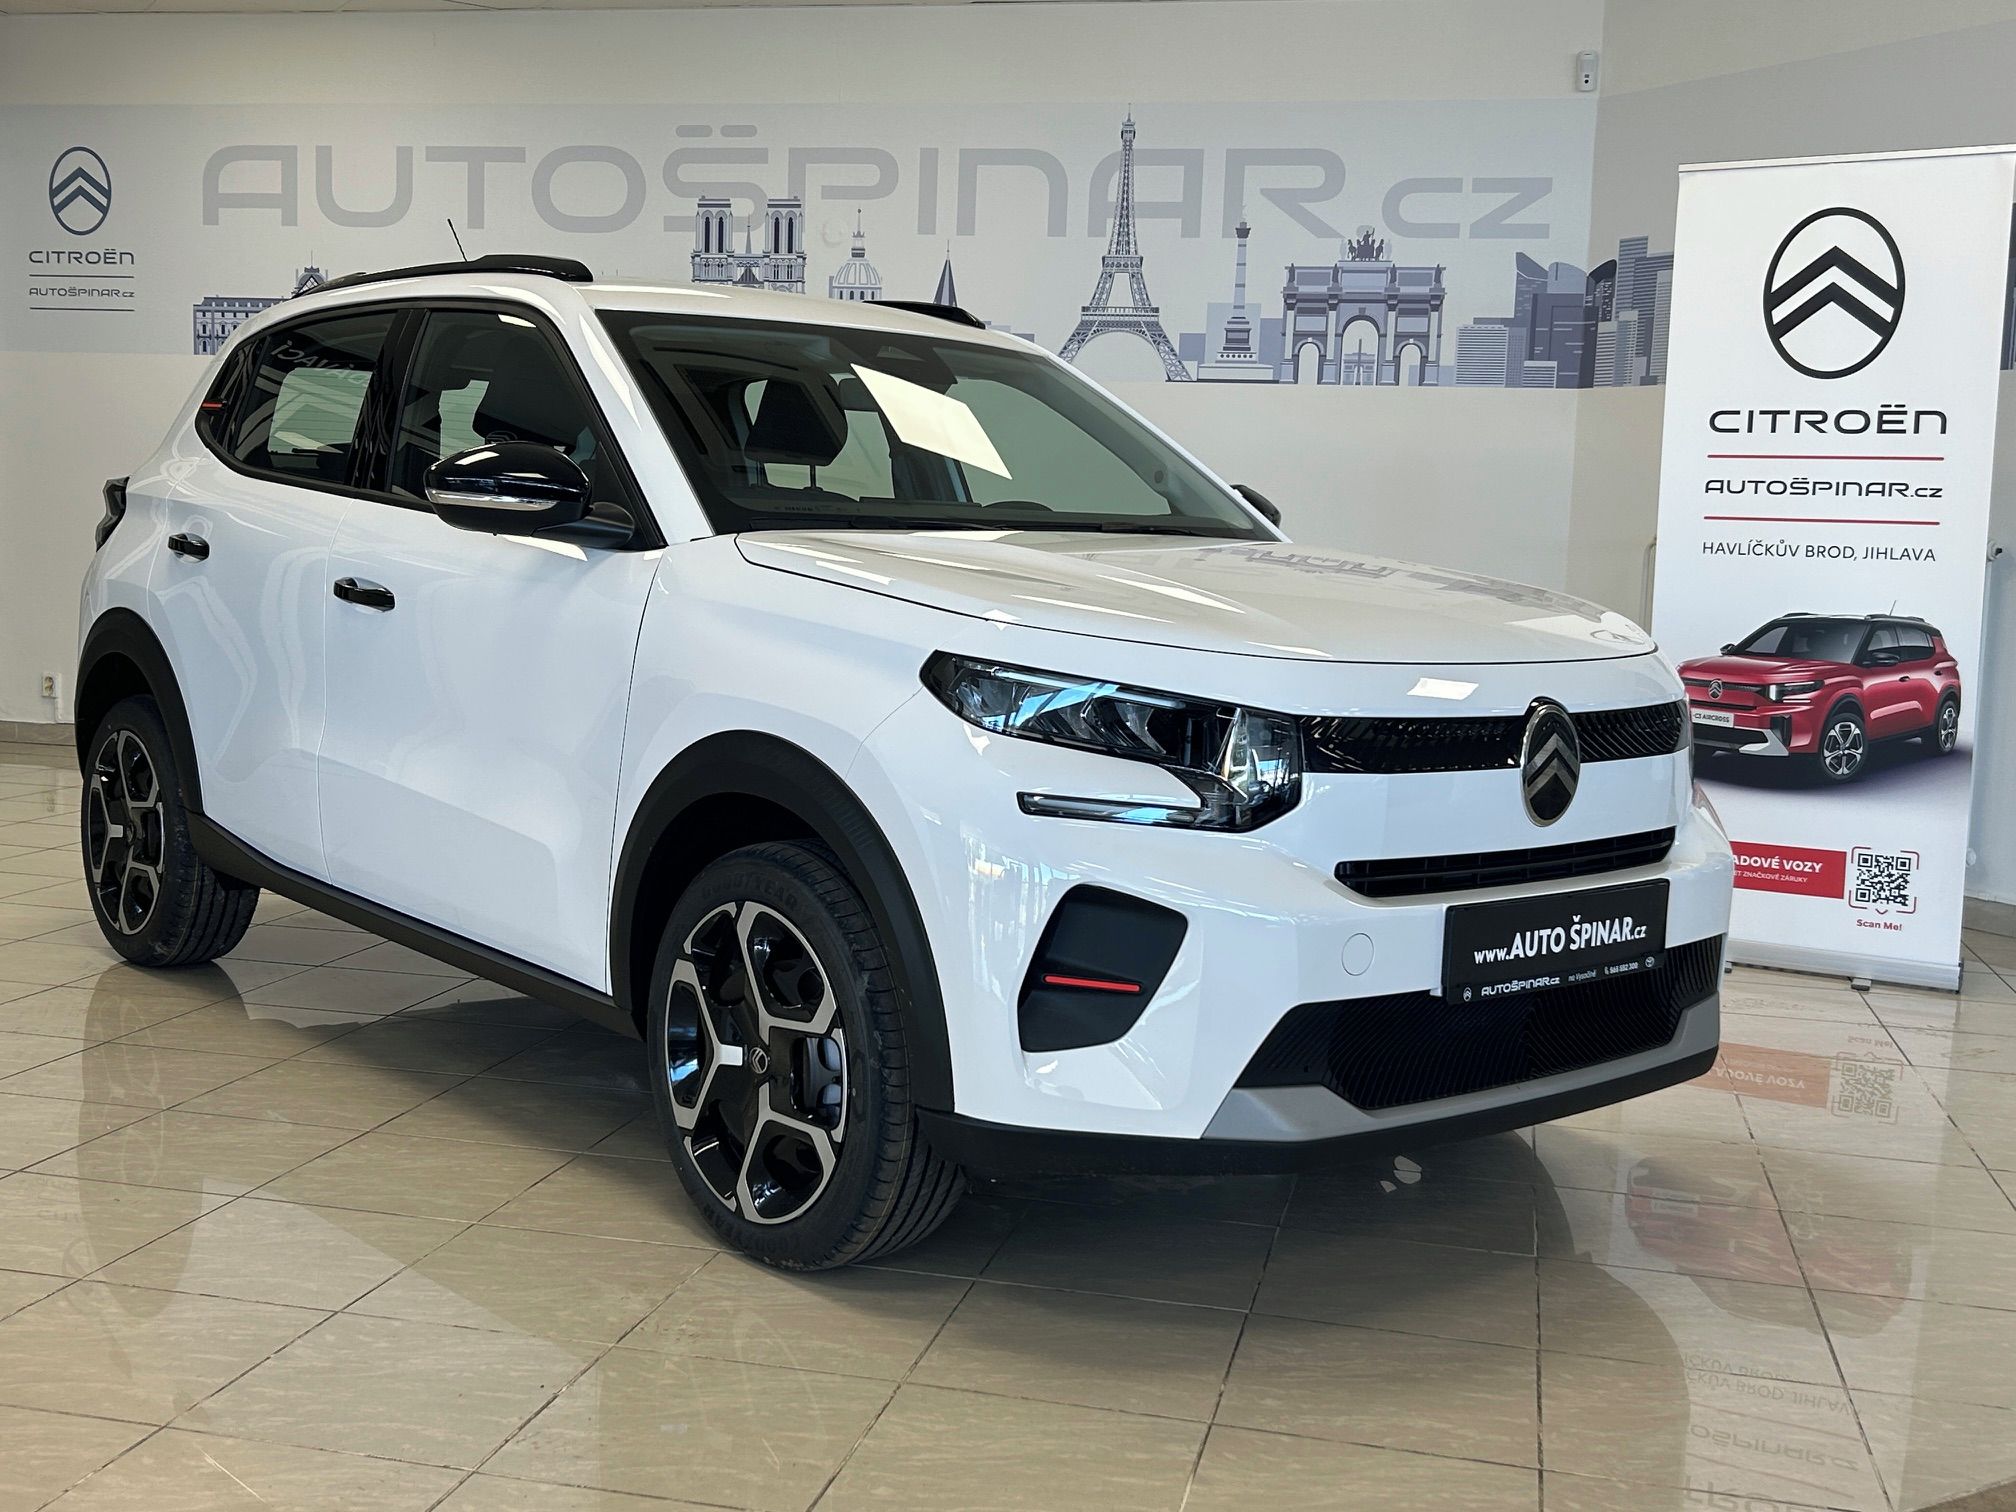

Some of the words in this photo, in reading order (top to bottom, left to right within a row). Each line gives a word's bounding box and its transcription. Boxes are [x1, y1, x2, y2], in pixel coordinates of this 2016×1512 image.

[28, 248, 135, 265] CITROËN
[1708, 403, 1948, 435] CITROËN
[1702, 539, 1801, 558] HAVLÍČKŮV
[1805, 545, 1857, 562] BROD,
[1862, 546, 1936, 562] JIHLAVA
[1702, 713, 1730, 723] AIRCROSS
[1782, 859, 1823, 874] VOZY
[1780, 874, 1809, 883] ZÁRUKY
[1856, 919, 1881, 929] Scan
[1883, 921, 1902, 932] Me!
[1474, 926, 1564, 964] www.AUTO
[1570, 914, 1647, 951] ŠPINAR.cz
